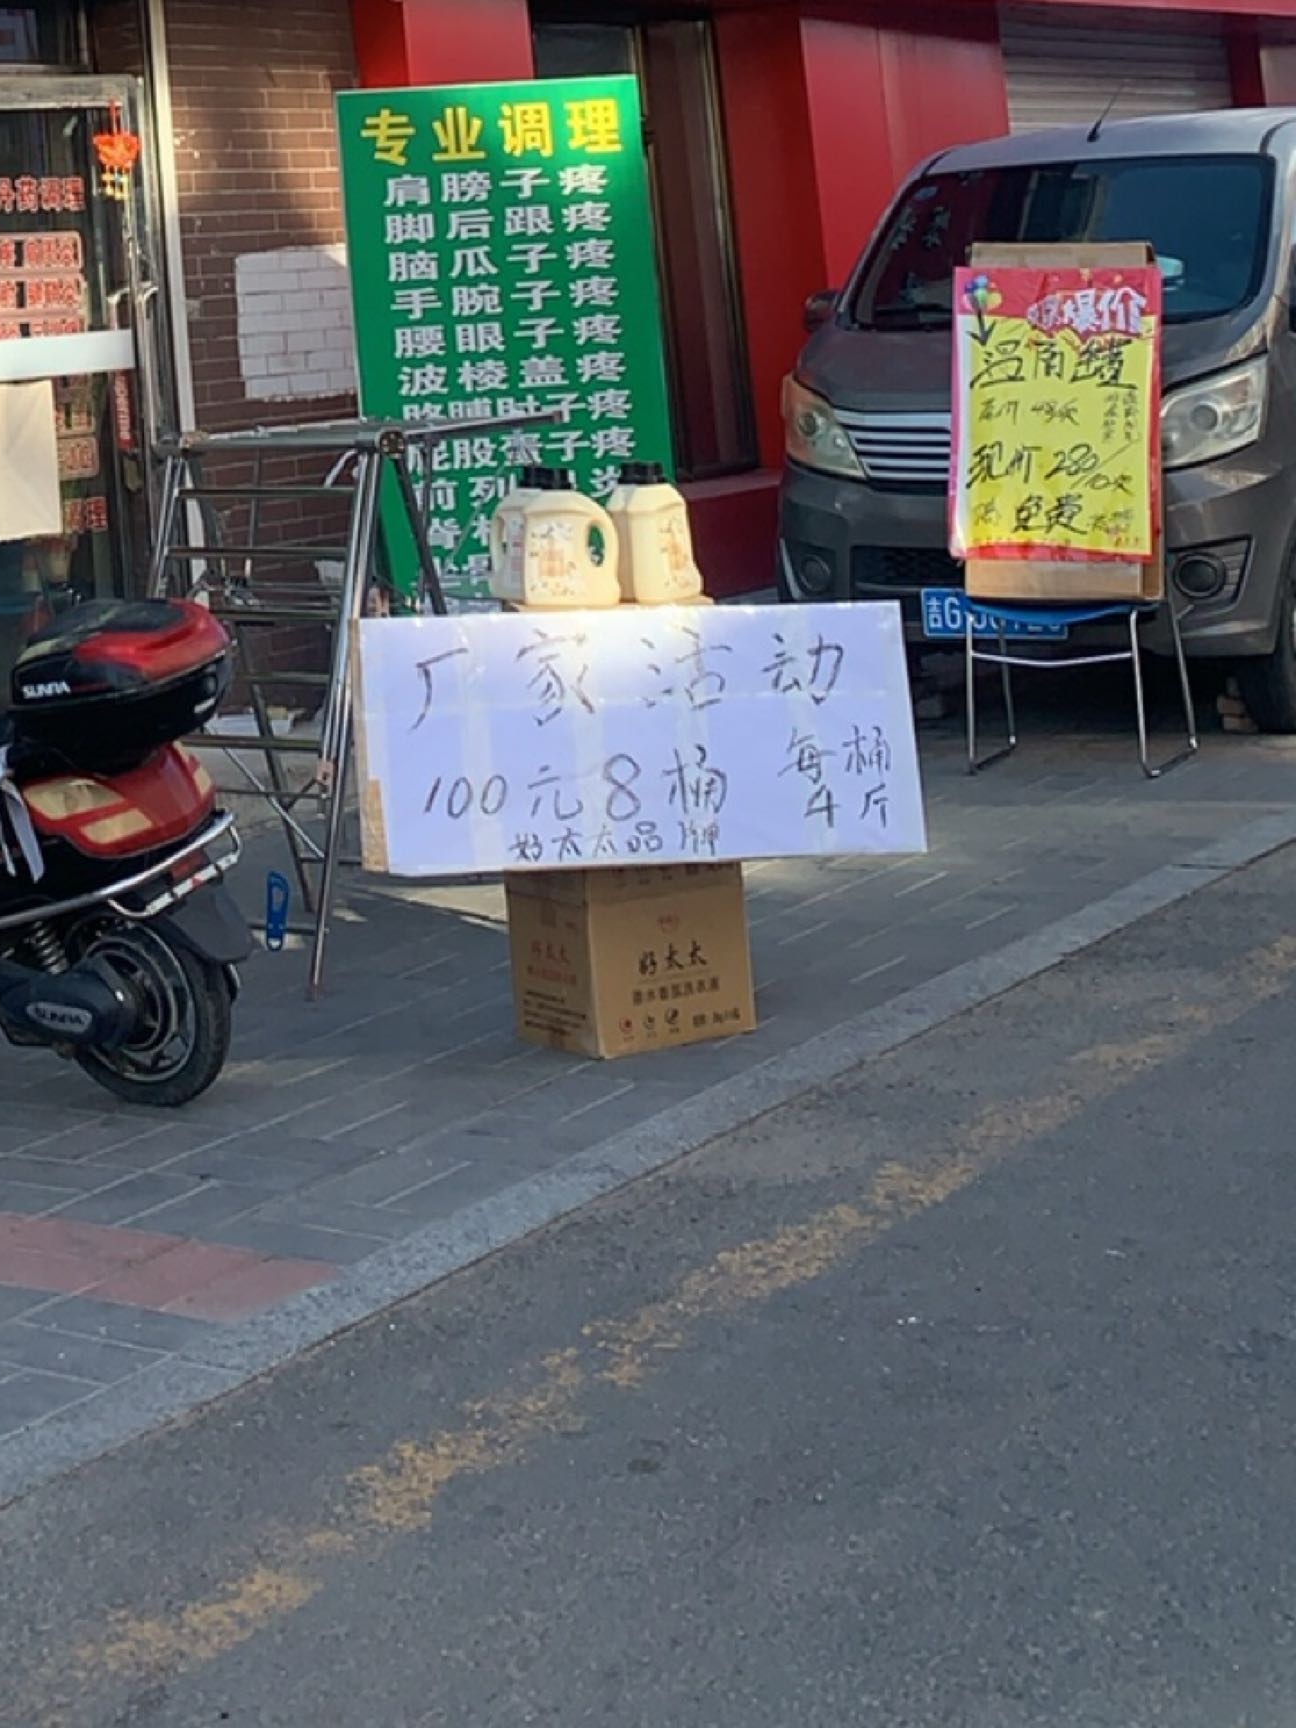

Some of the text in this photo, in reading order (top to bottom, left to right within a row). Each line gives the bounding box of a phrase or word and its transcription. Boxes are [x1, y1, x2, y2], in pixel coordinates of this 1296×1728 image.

[360, 98, 623, 167] 专业调理
[383, 163, 609, 207] 肩膀子疼
[384, 201, 612, 244] 脚后跟疼
[388, 238, 615, 282] 脑瓜子疼
[390, 275, 619, 320] 手腕子疼
[394, 313, 622, 359] 腰眼子疼
[398, 351, 626, 397] 波棱盖疼
[412, 465, 622, 511] 前列炎
[410, 627, 844, 729] 厂家活动
[638, 940, 708, 976] 好太太
